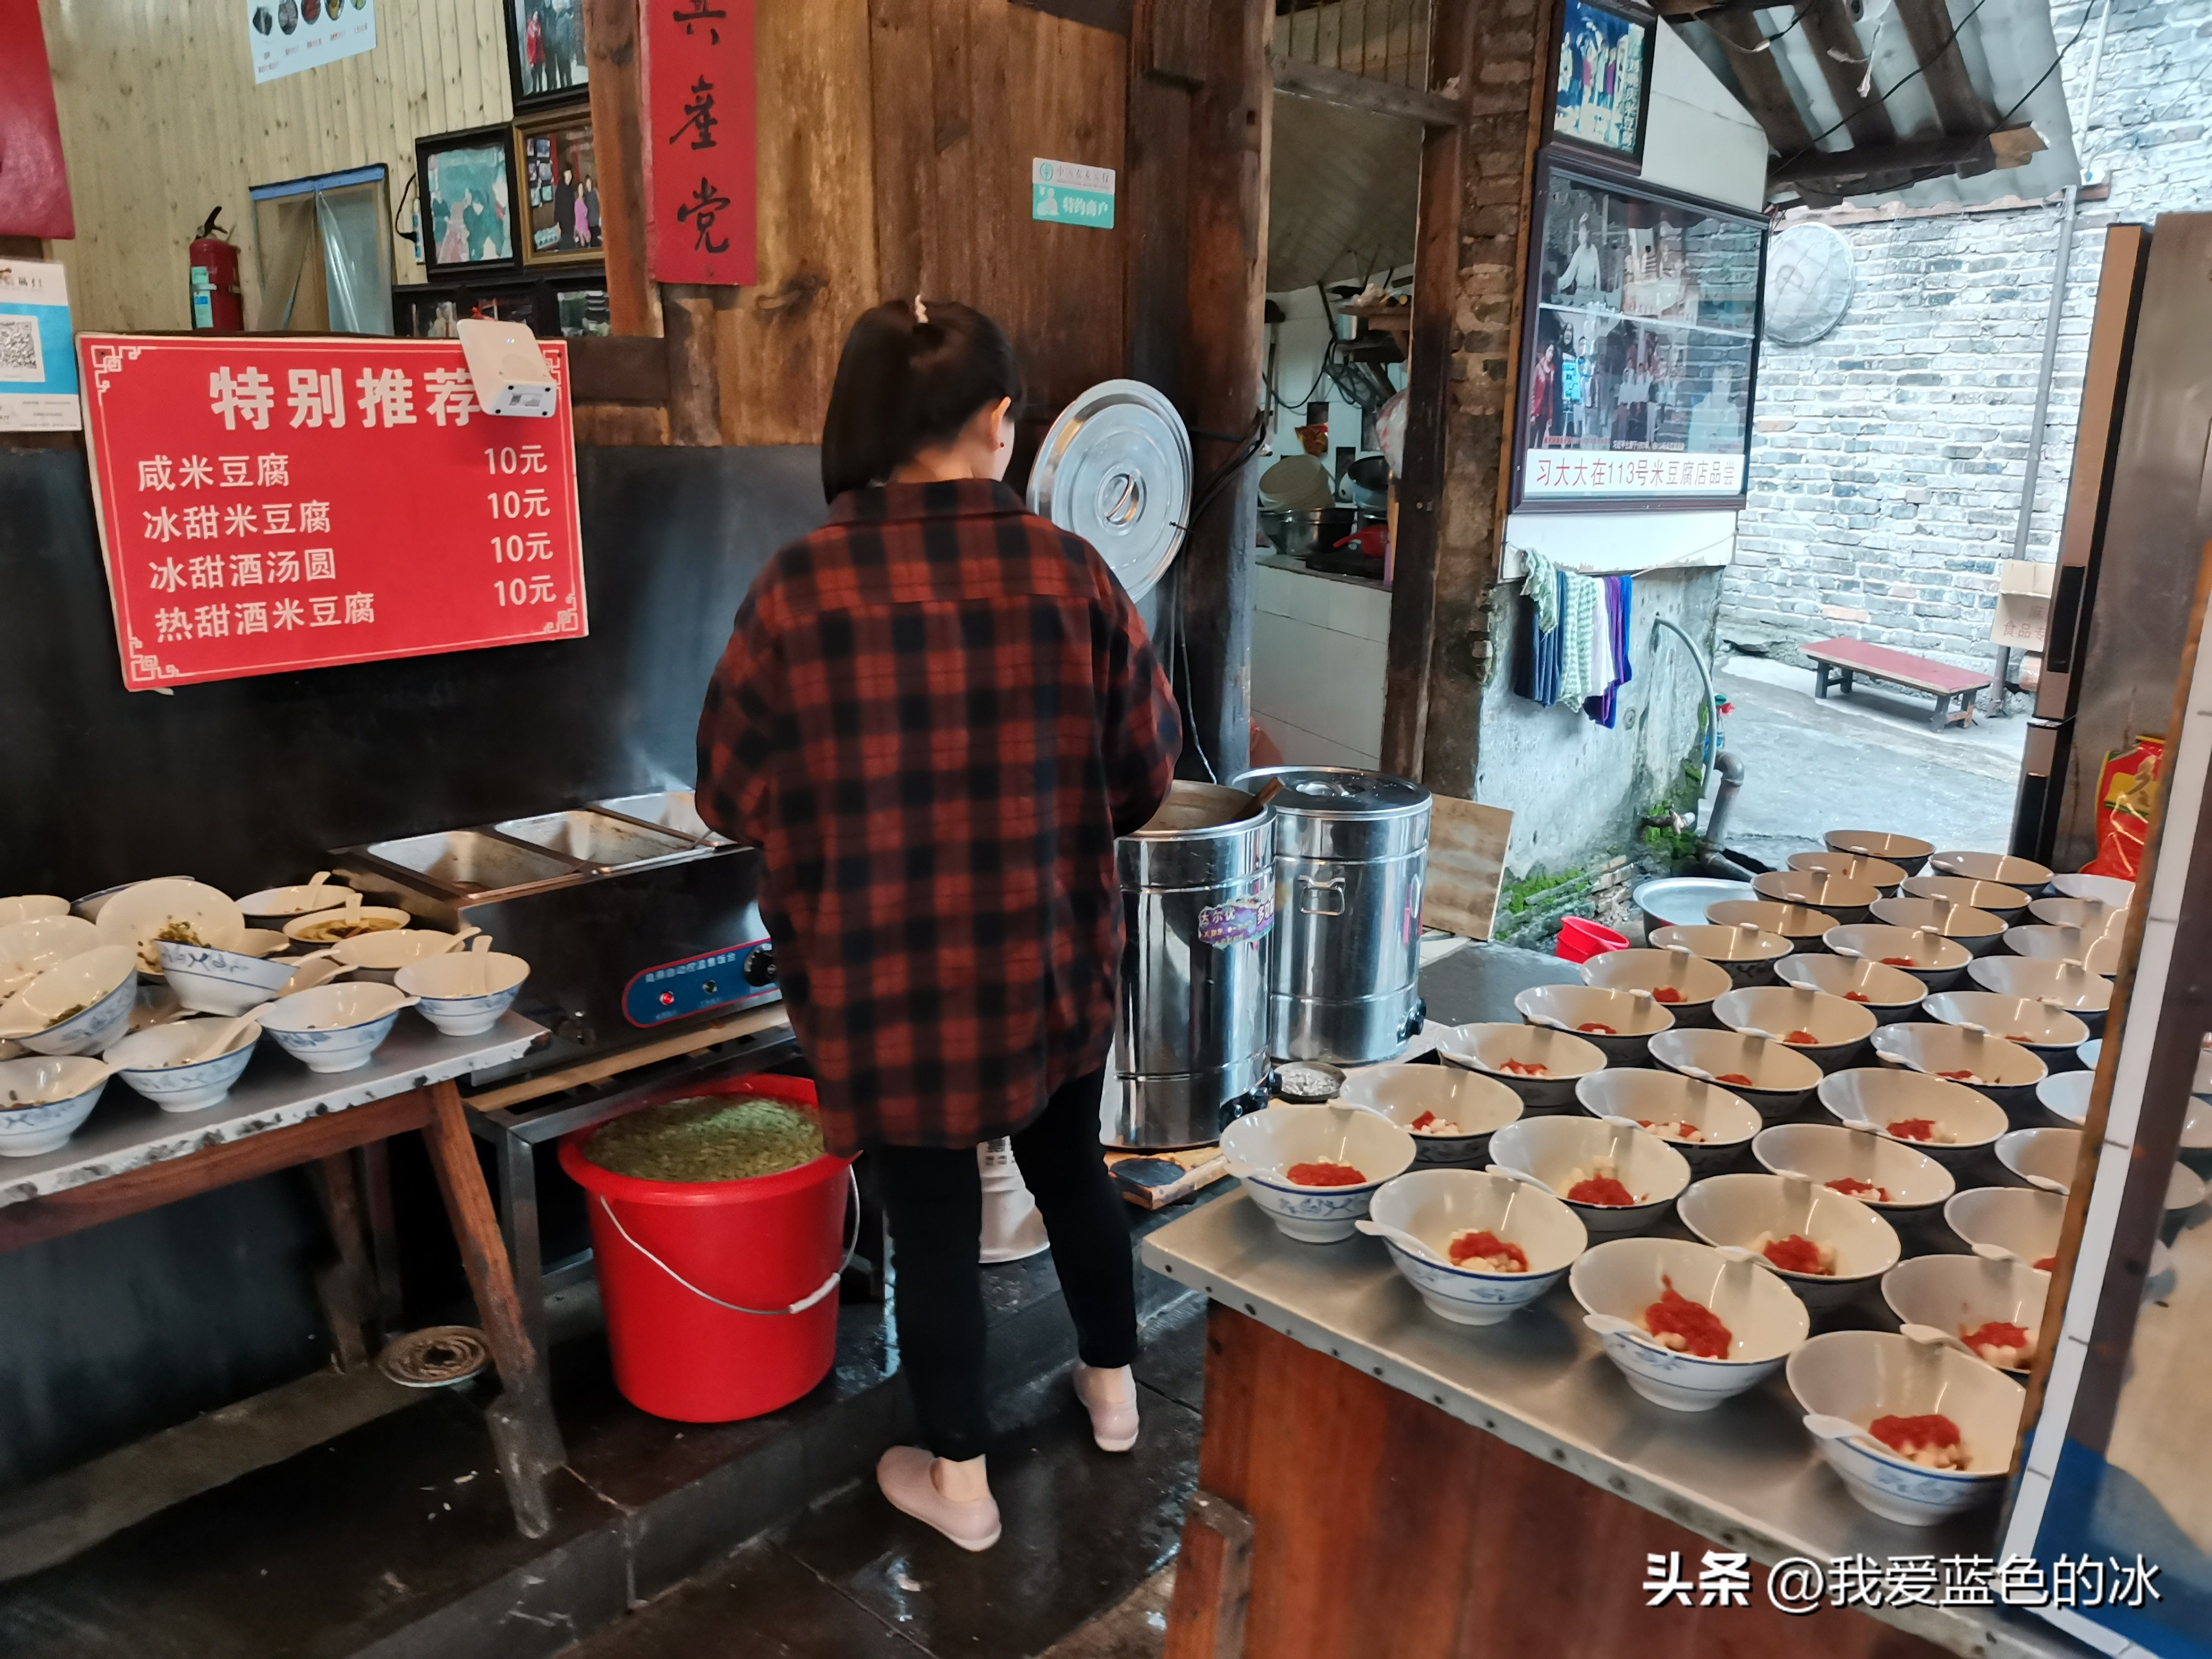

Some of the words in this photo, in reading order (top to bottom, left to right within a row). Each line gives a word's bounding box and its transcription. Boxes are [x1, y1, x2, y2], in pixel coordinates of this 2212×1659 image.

[209, 366, 483, 431] 特别推荐
[138, 453, 290, 492] 咸米豆腐
[485, 445, 548, 476] 10元
[1536, 458, 1736, 487] 习大大在113号米豆腐店品尝
[143, 500, 331, 543] 冰甜米豆腐
[488, 488, 551, 520] 10元
[149, 548, 337, 593] 冰甜酒汤圆
[491, 532, 554, 564] 10元
[155, 592, 375, 644] 热甜酒米豆腐
[494, 574, 557, 608] 10元
